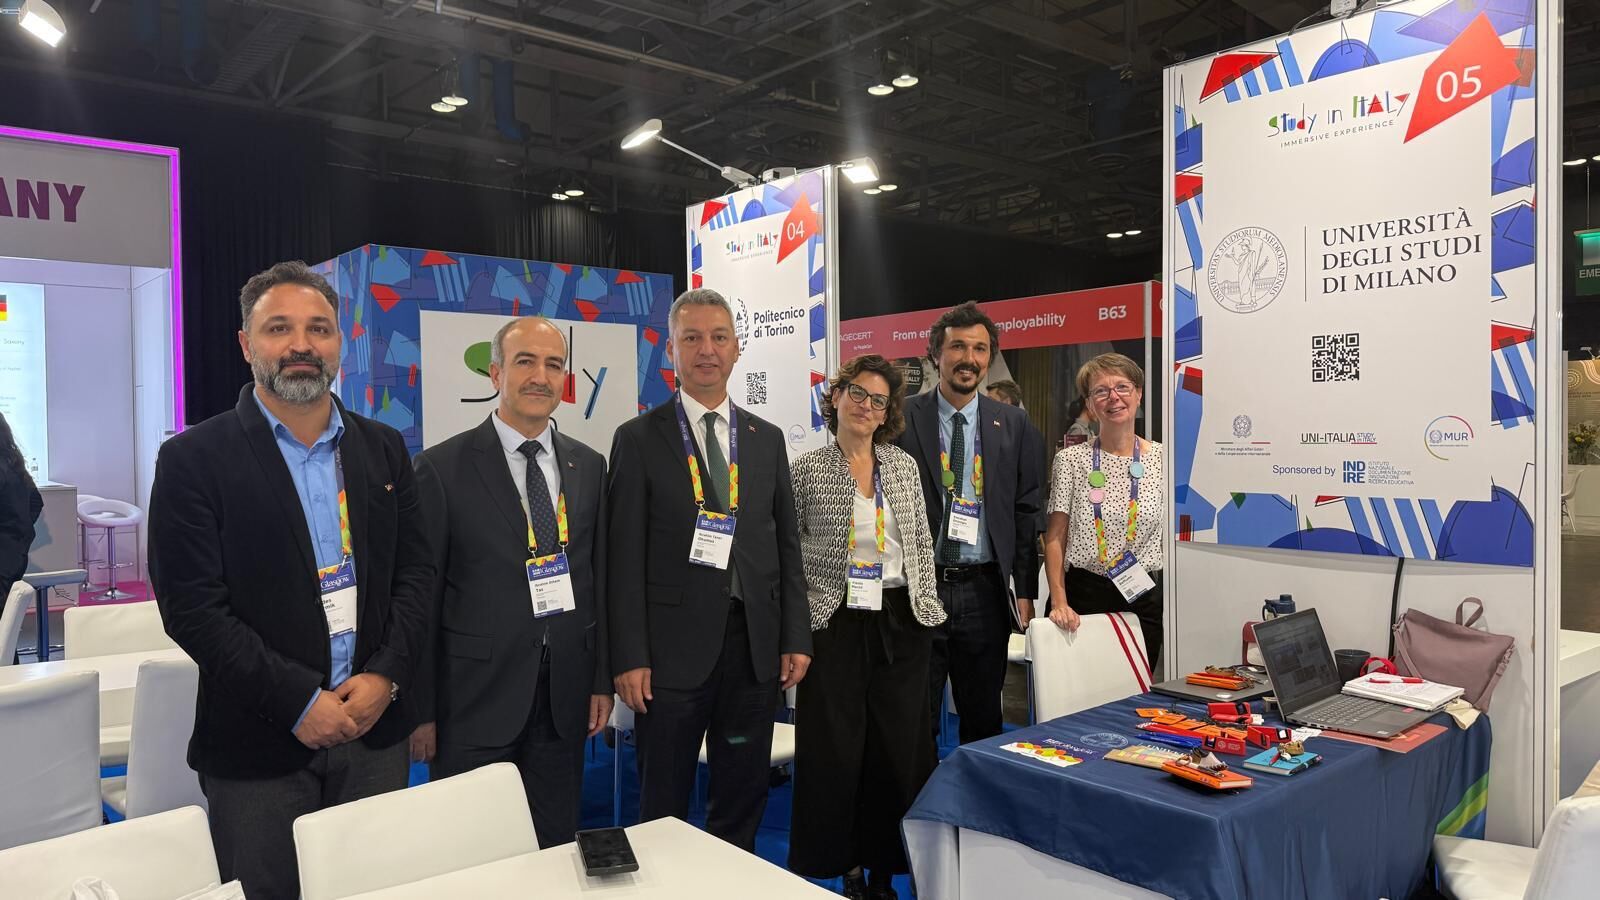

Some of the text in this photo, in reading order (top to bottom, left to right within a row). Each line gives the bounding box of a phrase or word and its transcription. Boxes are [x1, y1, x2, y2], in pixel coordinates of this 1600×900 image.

[1436, 65, 1482, 102] 05
[1327, 109, 1343, 125] in
[1280, 120, 1394, 149] IMMERSIVE EXPERIENCE
[787, 221, 805, 240] 04
[1322, 206, 1472, 247] UNIVERSITÀ
[1322, 234, 1482, 270] DEGLI STUDI
[1209, 228, 1286, 302] UNIVERSITAS STUDIORUM MEDIOLANENSIS
[1322, 264, 1457, 294] DI MILANO
[754, 306, 805, 324] Politecnico
[1098, 305, 1127, 320] B63
[754, 323, 794, 338] di Torino
[893, 331, 917, 341] From
[994, 313, 1066, 332] mployability
[1301, 432, 1356, 443] UNI-ITALIA
[1444, 432, 1469, 441] MUR
[1272, 464, 1336, 476] Sponsored by
[1343, 461, 1366, 471] IND
[1343, 472, 1366, 484] IRE
